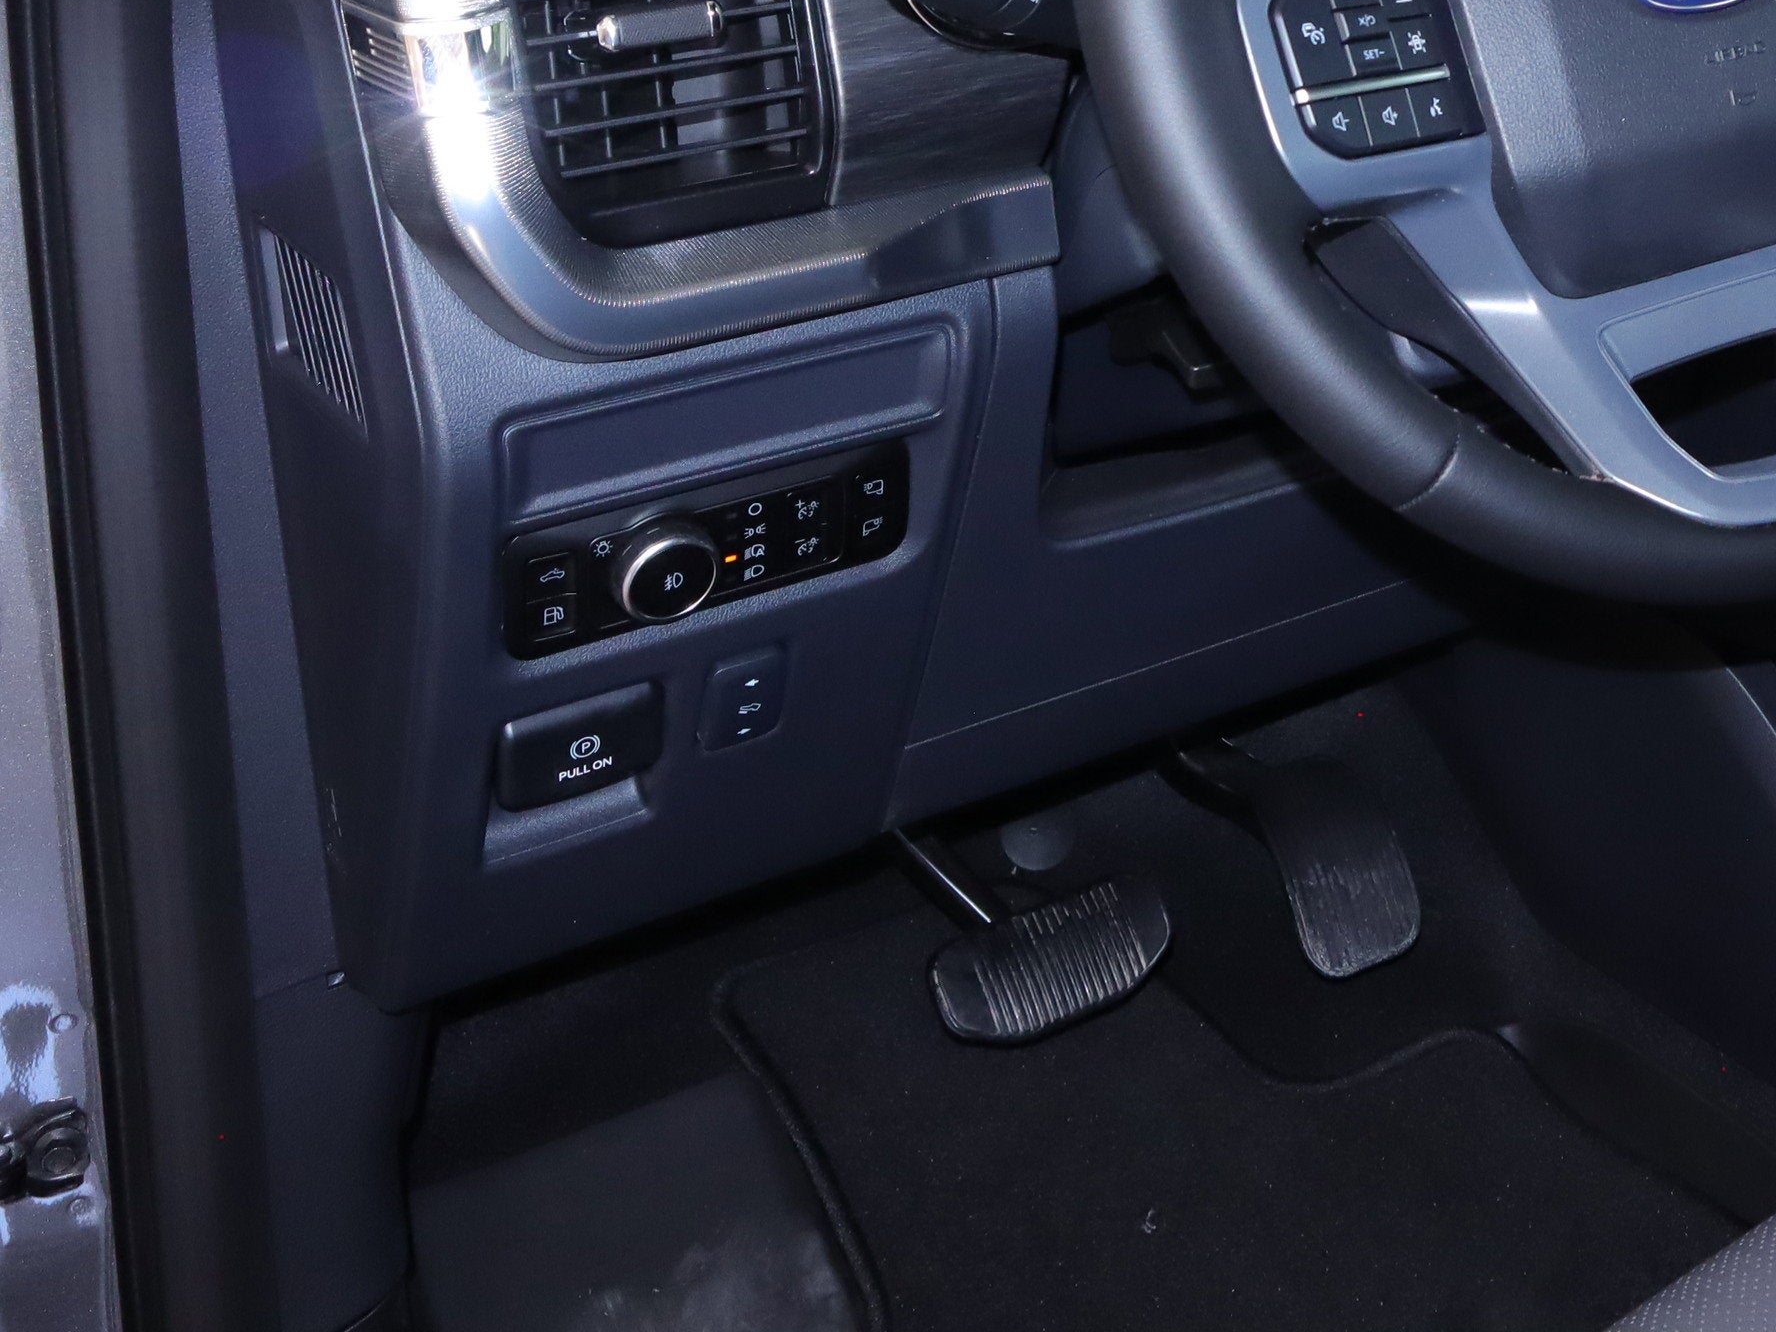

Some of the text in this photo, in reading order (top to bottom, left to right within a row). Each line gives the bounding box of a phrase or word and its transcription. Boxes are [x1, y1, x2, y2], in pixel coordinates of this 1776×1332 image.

[1362, 48, 1386, 61] SET-
[581, 741, 591, 754] P
[558, 756, 613, 782] PULL ON
